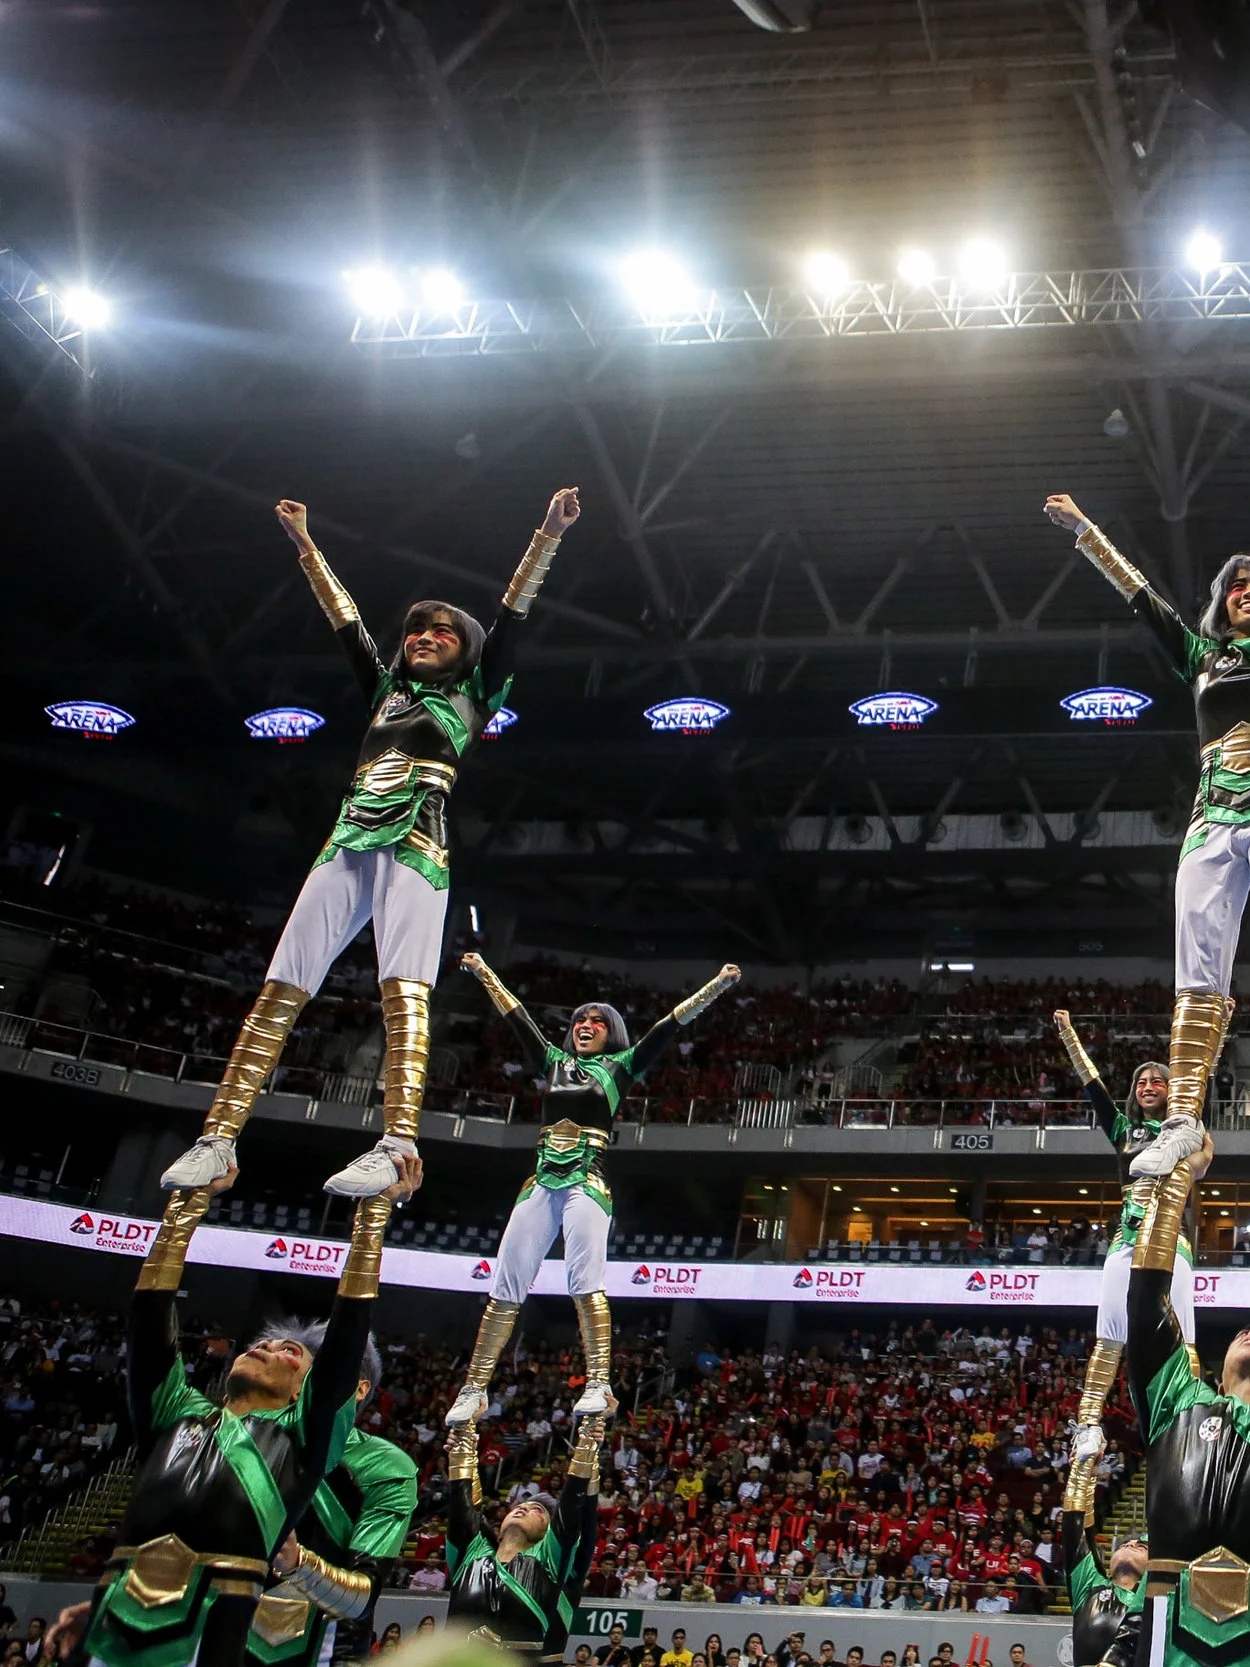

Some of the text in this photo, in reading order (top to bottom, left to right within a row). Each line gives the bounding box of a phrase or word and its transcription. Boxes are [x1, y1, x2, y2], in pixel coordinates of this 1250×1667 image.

[861, 706, 919, 721] ARENA
[1073, 701, 1135, 716] ARENA
[61, 711, 117, 734] ARENA
[259, 718, 308, 736] ARENA
[655, 711, 713, 727] ARENA
[54, 1064, 99, 1085] 403B
[955, 1135, 988, 1149] 405
[97, 1219, 156, 1242] PLDT
[95, 1237, 146, 1252] Enterprise
[290, 1243, 344, 1263] PLDT
[289, 1260, 336, 1273] Enterprise
[653, 1268, 701, 1284] PLDT
[816, 1271, 865, 1287] PLDT
[990, 1274, 1039, 1290] PLDT
[1194, 1276, 1220, 1292] DT
[653, 1285, 695, 1295] Enterprise
[816, 1289, 859, 1298] Enterprise
[990, 1292, 1034, 1301] Enterprise
[586, 1610, 629, 1633] 105
